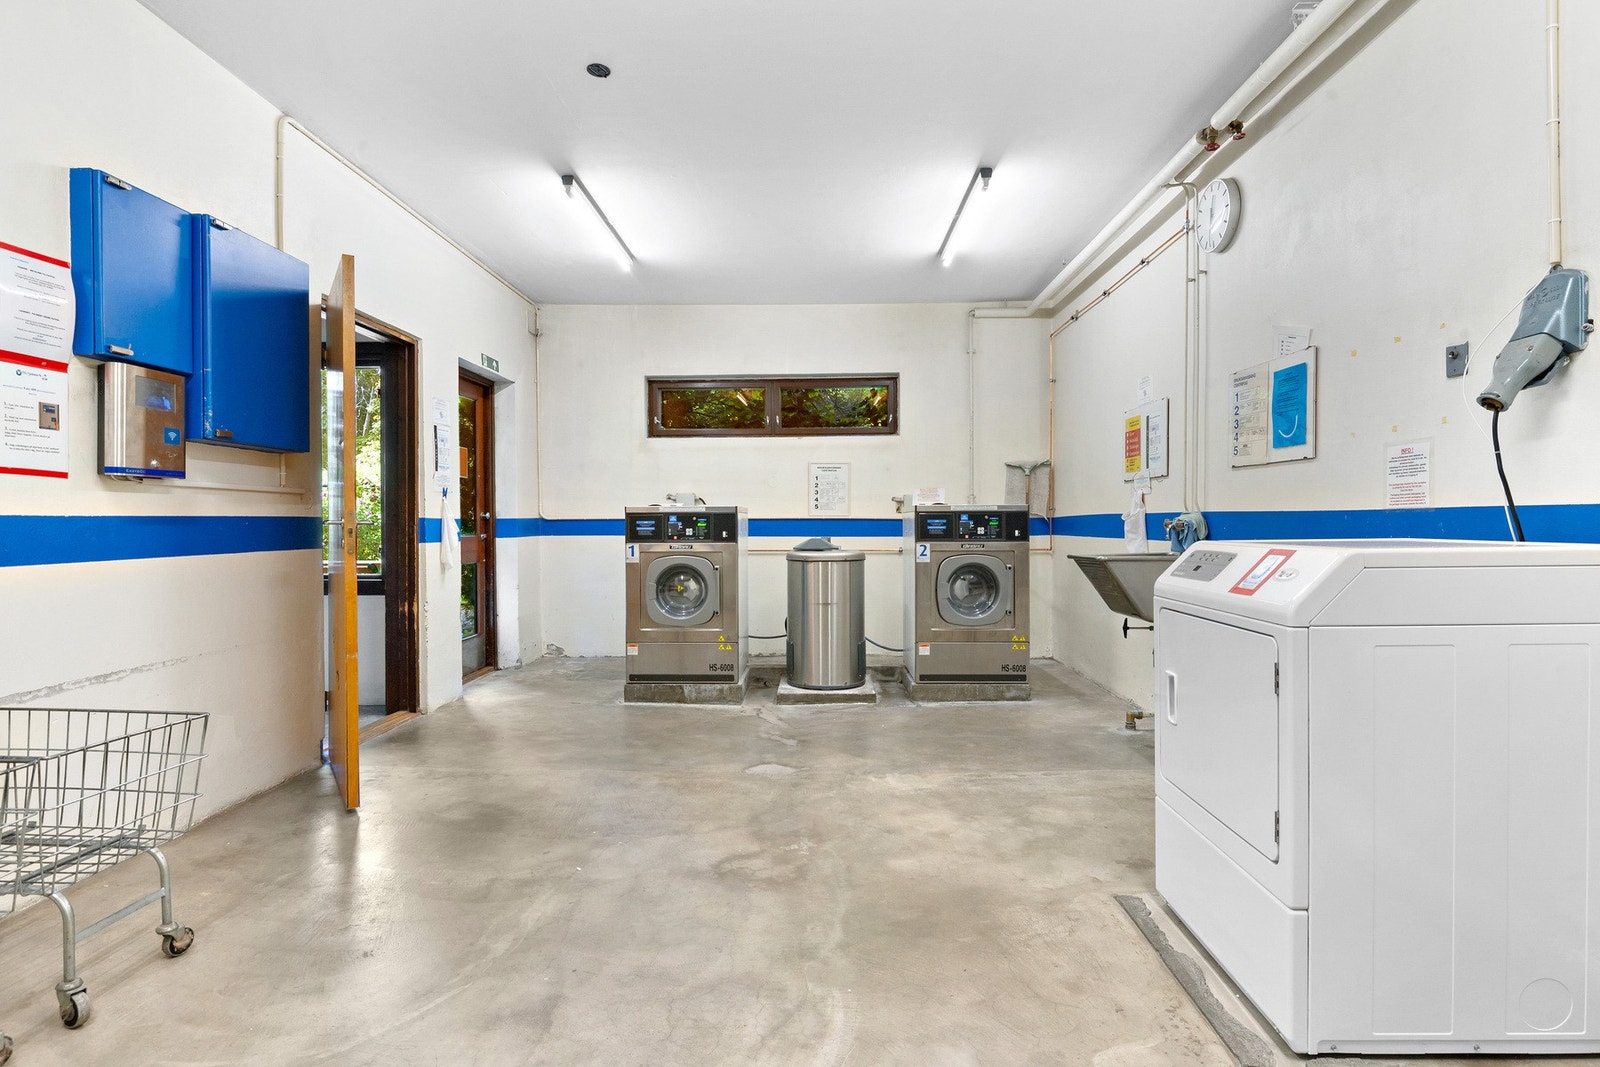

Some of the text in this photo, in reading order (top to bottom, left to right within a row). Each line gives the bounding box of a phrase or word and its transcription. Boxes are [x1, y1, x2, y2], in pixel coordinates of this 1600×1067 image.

[1235, 392, 1239, 402] 1
[1234, 406, 1240, 416] 2
[1234, 419, 1239, 429] 3
[1234, 432, 1238, 442] 4
[1233, 446, 1238, 456] 5
[628, 545, 634, 557] 1
[920, 544, 927, 556] 2
[1001, 664, 1026, 672] HS-6008
